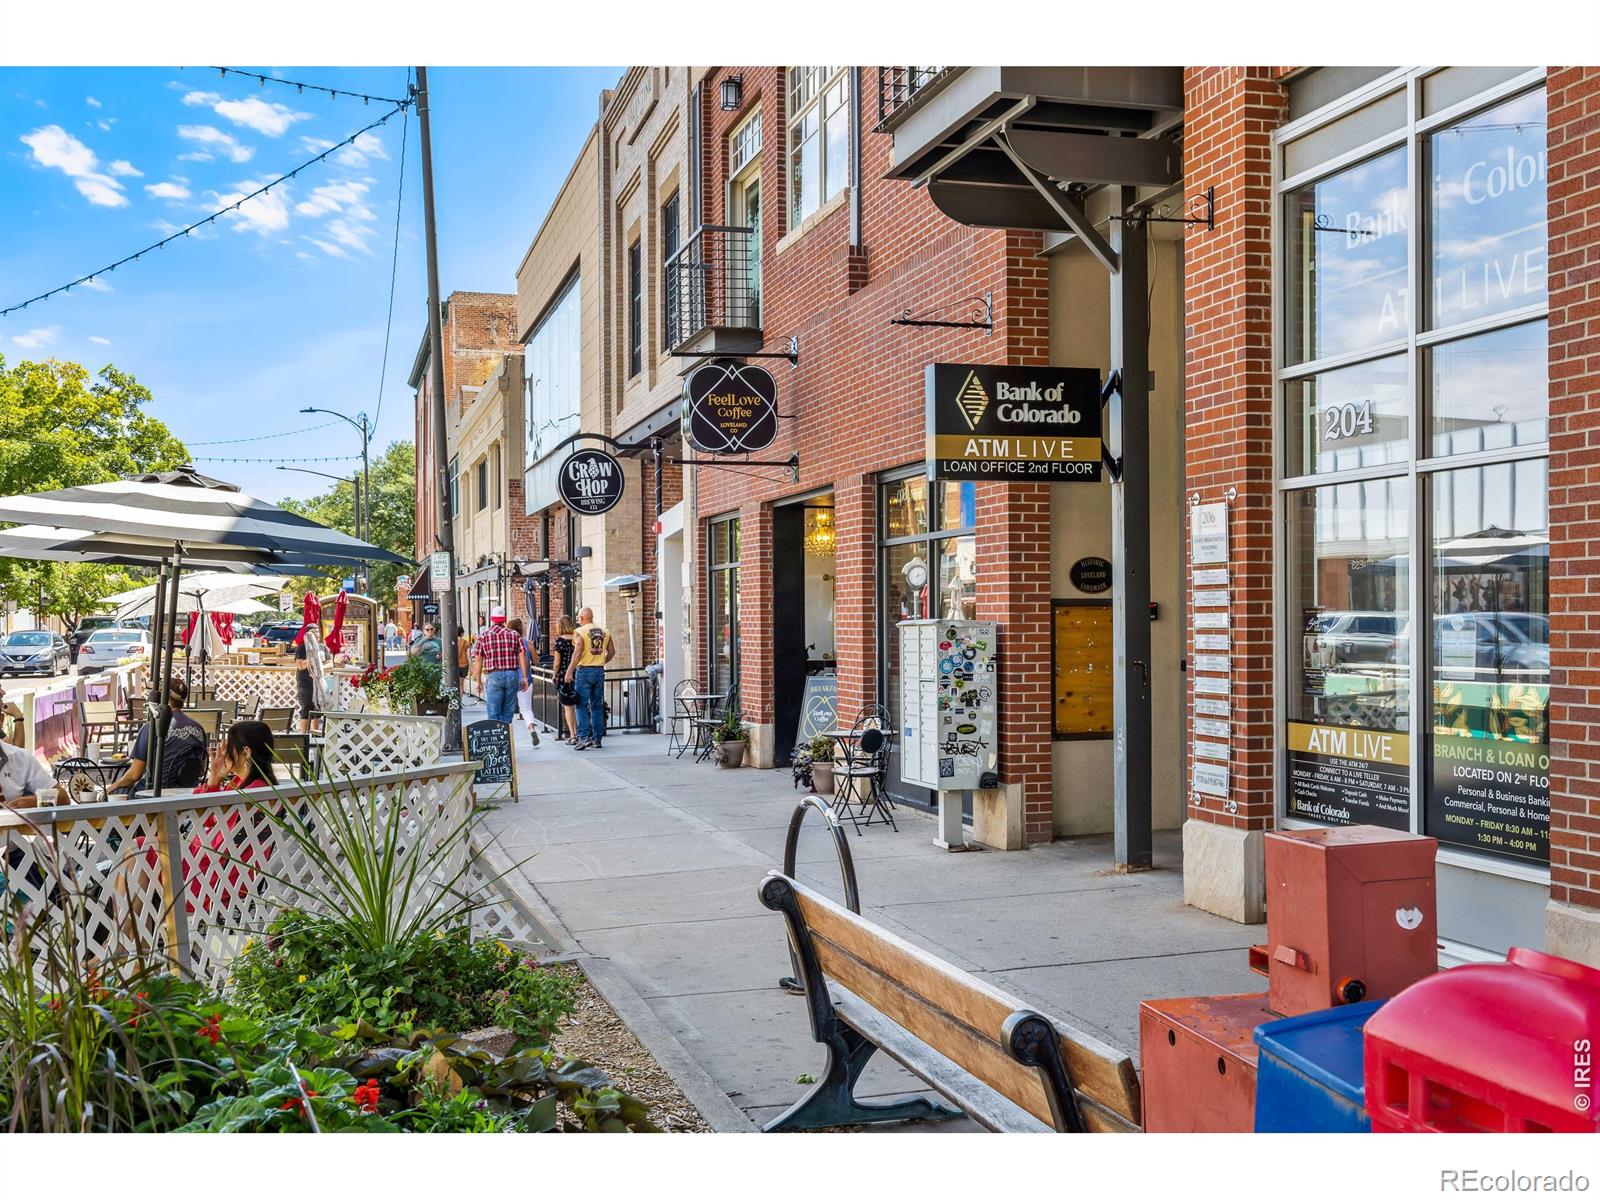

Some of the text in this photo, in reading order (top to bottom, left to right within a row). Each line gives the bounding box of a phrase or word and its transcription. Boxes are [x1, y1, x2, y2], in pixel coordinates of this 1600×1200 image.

[1346, 192, 1408, 249] Bank
[1462, 246, 1544, 310] LIVE
[708, 394, 761, 406] FeelLove
[996, 381, 1065, 402] Bank of
[718, 407, 752, 420] Coffee
[997, 403, 1081, 424] Colorado
[1324, 400, 1373, 441] 204
[964, 439, 1074, 459] ATM LIVE
[944, 461, 1093, 475] LOAN OFFICE 2nd FLOOR
[576, 478, 608, 498] HOP
[1201, 511, 1216, 525] 206
[472, 738, 498, 756] honey
[1308, 728, 1393, 762] ATM LIVE
[1348, 760, 1358, 768] ATM
[1434, 744, 1482, 763] BRANCH
[1486, 749, 1496, 764] &
[1499, 750, 1535, 768] LOAN
[1292, 770, 1312, 778] MONDAY
[1319, 766, 1341, 775] CONNECT
[1353, 771, 1363, 779] LIVE
[1363, 772, 1380, 781] TELLER
[1453, 766, 1494, 781] LOCATED
[1496, 771, 1512, 784] ON
[1514, 773, 1528, 785] 2nd
[1457, 785, 1487, 798] Personal
[1488, 789, 1494, 799] &
[1495, 790, 1526, 804] Business
[1297, 799, 1350, 819] Bank of Colorado
[1444, 796, 1550, 822] Commercial, Personal & Home
[1445, 814, 1474, 826] MONDAY
[1480, 819, 1504, 831] FRIDAY
[1505, 824, 1520, 834] 8:30
[1520, 826, 1533, 836] AM
[1477, 833, 1491, 843] 1:30
[1492, 835, 1503, 846] PM
[1509, 839, 1524, 849] 4:00
[1525, 841, 1537, 852] PM
